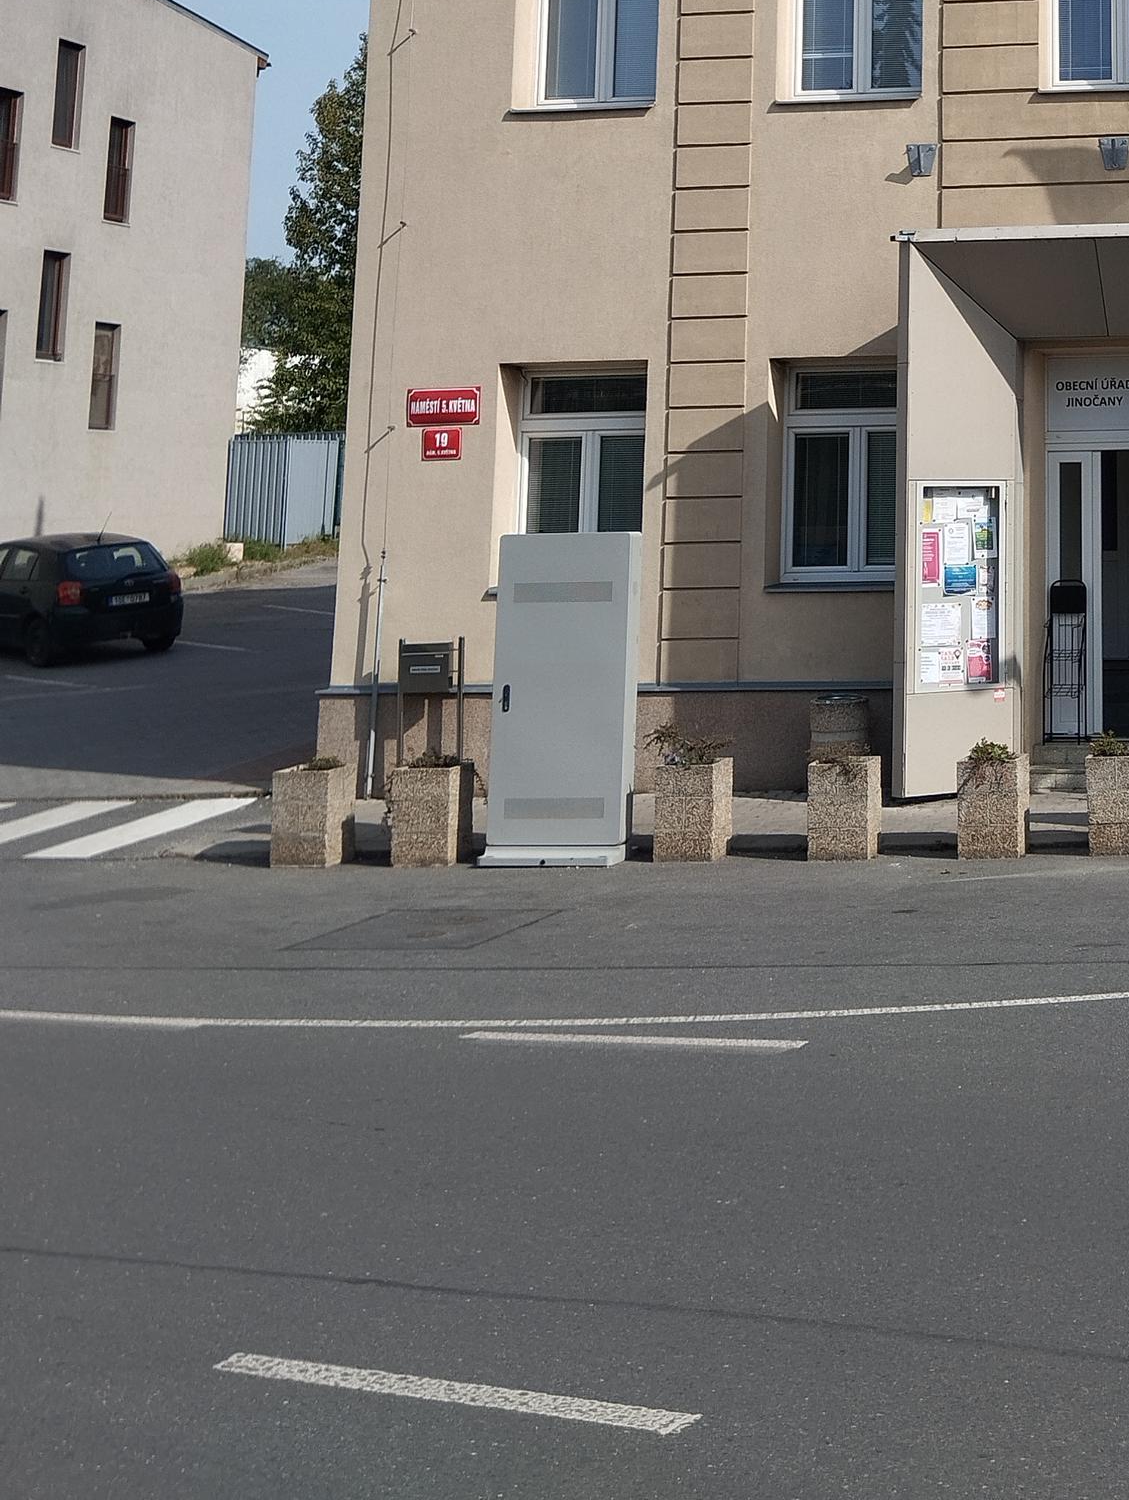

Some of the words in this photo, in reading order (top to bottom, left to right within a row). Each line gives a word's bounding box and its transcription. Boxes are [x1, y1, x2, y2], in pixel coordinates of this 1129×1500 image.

[1055, 377, 1098, 391] OBECNÍ
[410, 397, 441, 415] NÁMĚSTÍ
[1065, 395, 1124, 408] JINOČANY
[434, 432, 448, 448] 19
